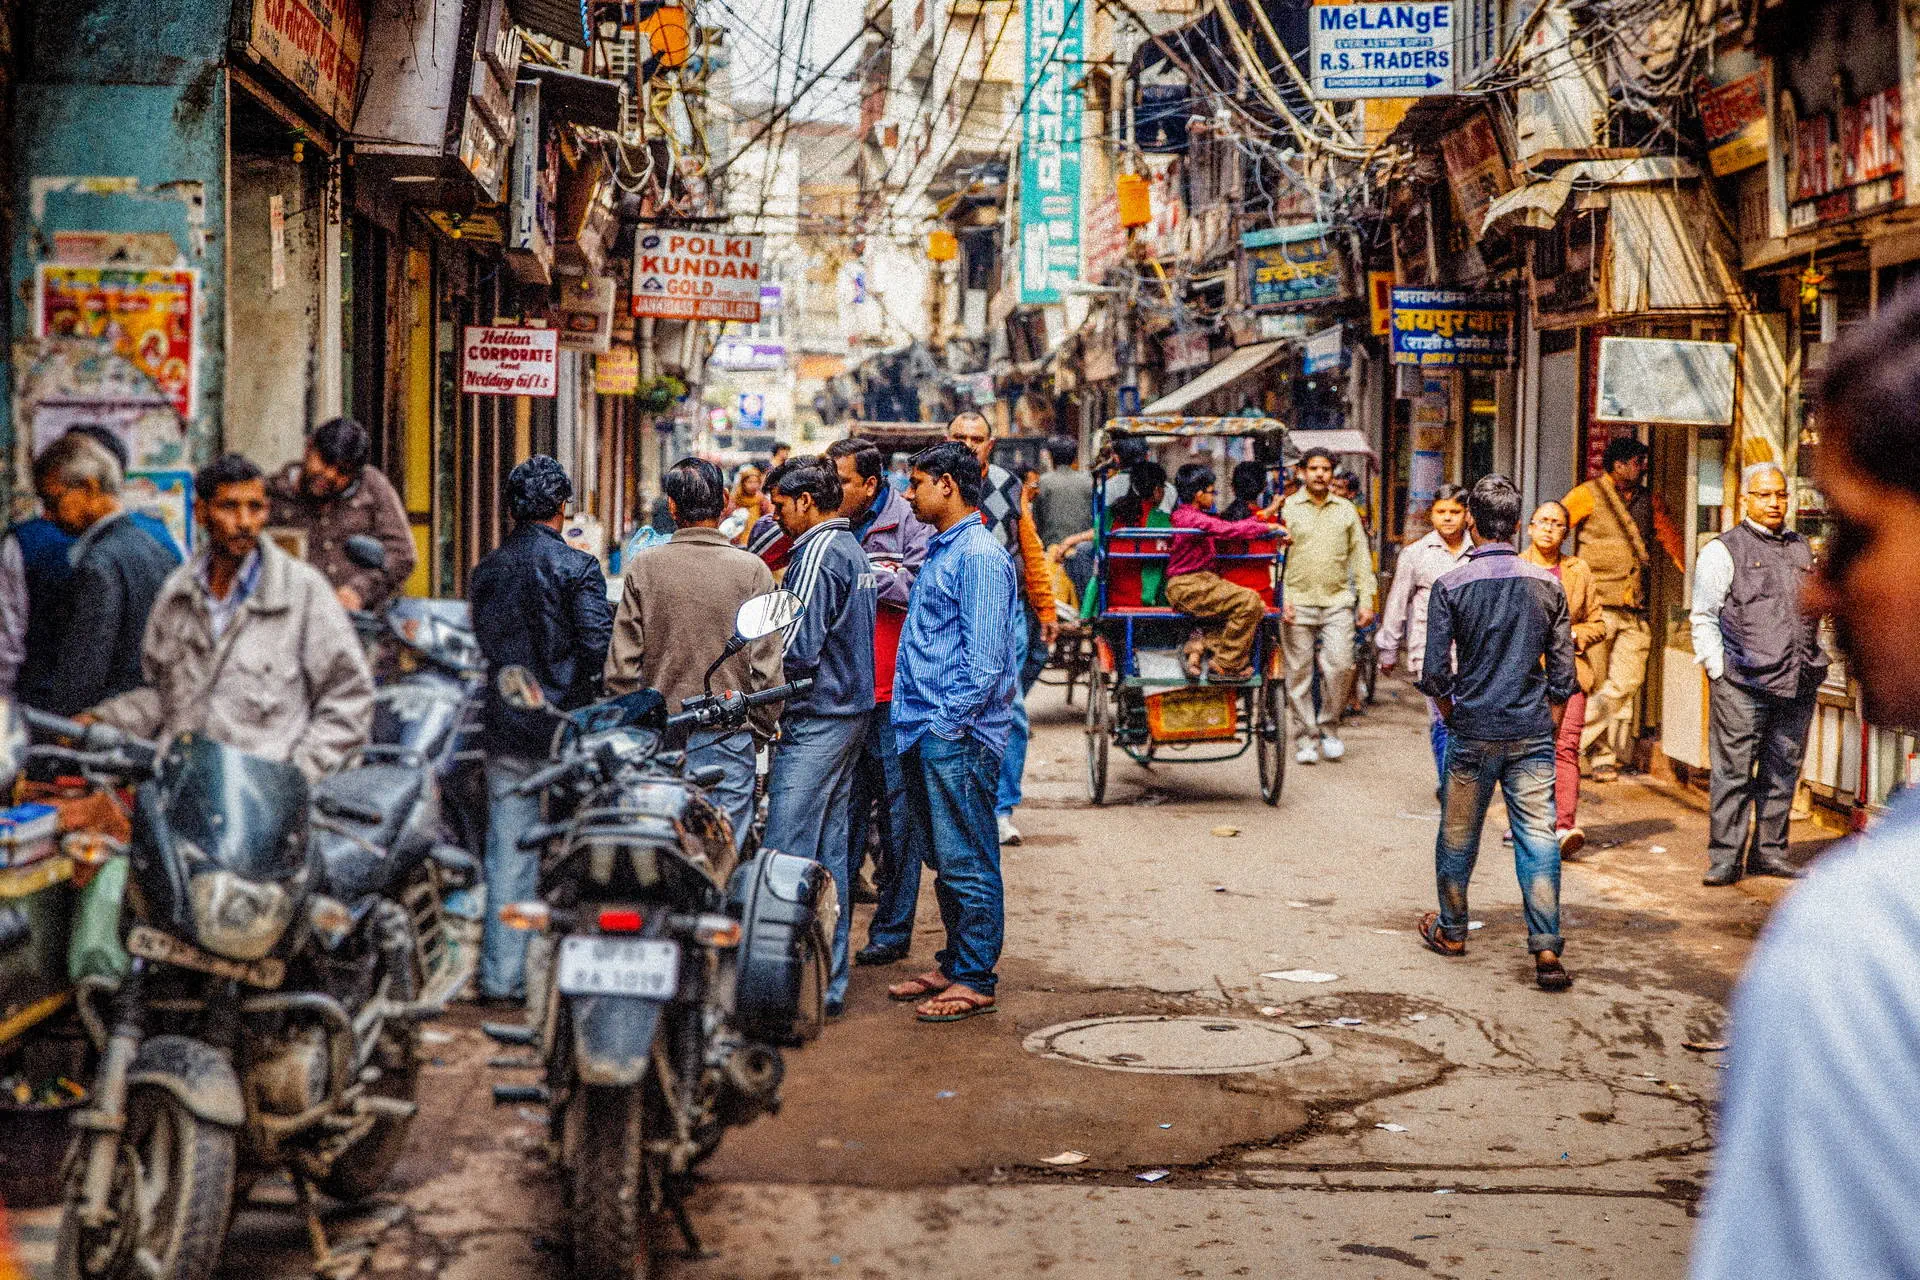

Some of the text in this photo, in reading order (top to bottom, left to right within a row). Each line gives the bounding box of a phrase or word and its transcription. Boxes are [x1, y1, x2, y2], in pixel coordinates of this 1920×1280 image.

[1320, 5, 1449, 34] MeLANgE
[1320, 50, 1449, 70] R.S. TRADERS
[669, 235, 753, 258] POLKI
[641, 255, 759, 280] KUNDAN
[667, 278, 714, 297] GOLD
[697, 300, 757, 319] JEWELLERS
[468, 346, 553, 362] CORPORATE
[463, 370, 515, 391] Wedding
